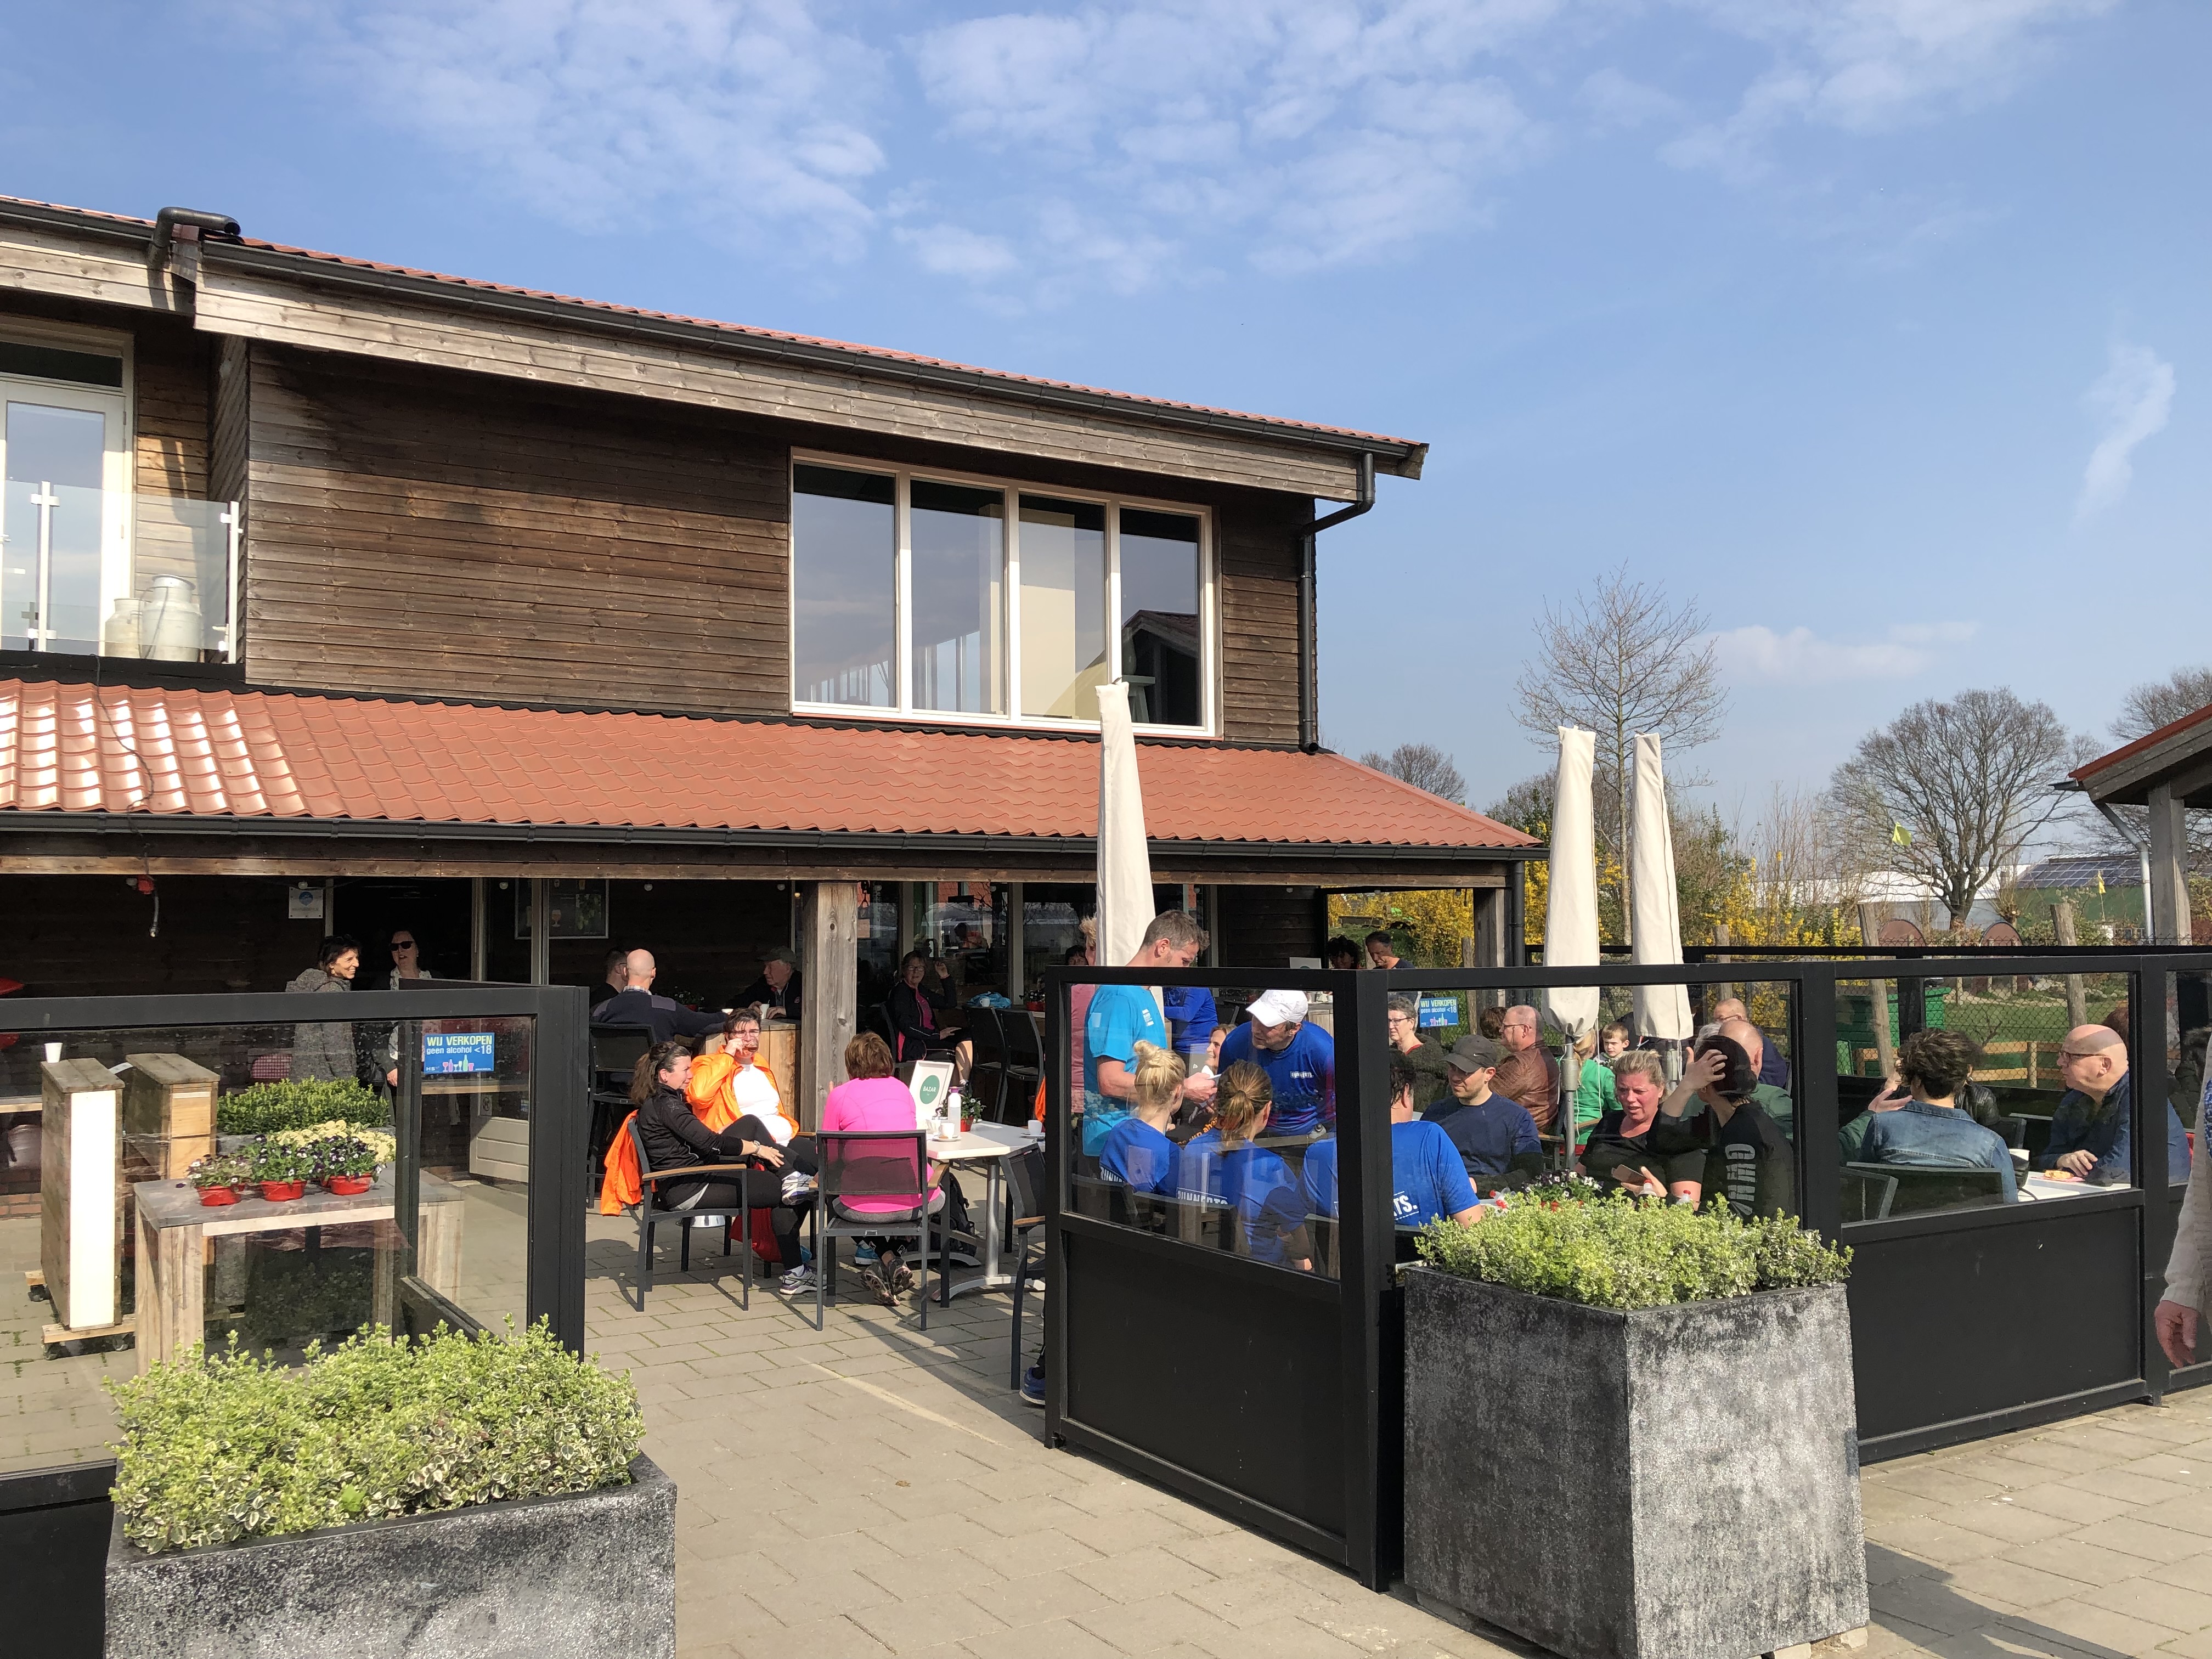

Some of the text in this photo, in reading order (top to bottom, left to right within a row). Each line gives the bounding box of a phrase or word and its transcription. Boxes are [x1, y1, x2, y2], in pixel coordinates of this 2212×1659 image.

[1431, 999, 1457, 1007] VERKOPEN
[427, 1035, 492, 1046] WIJ VERKOPEN
[474, 1045, 492, 1054] <18
